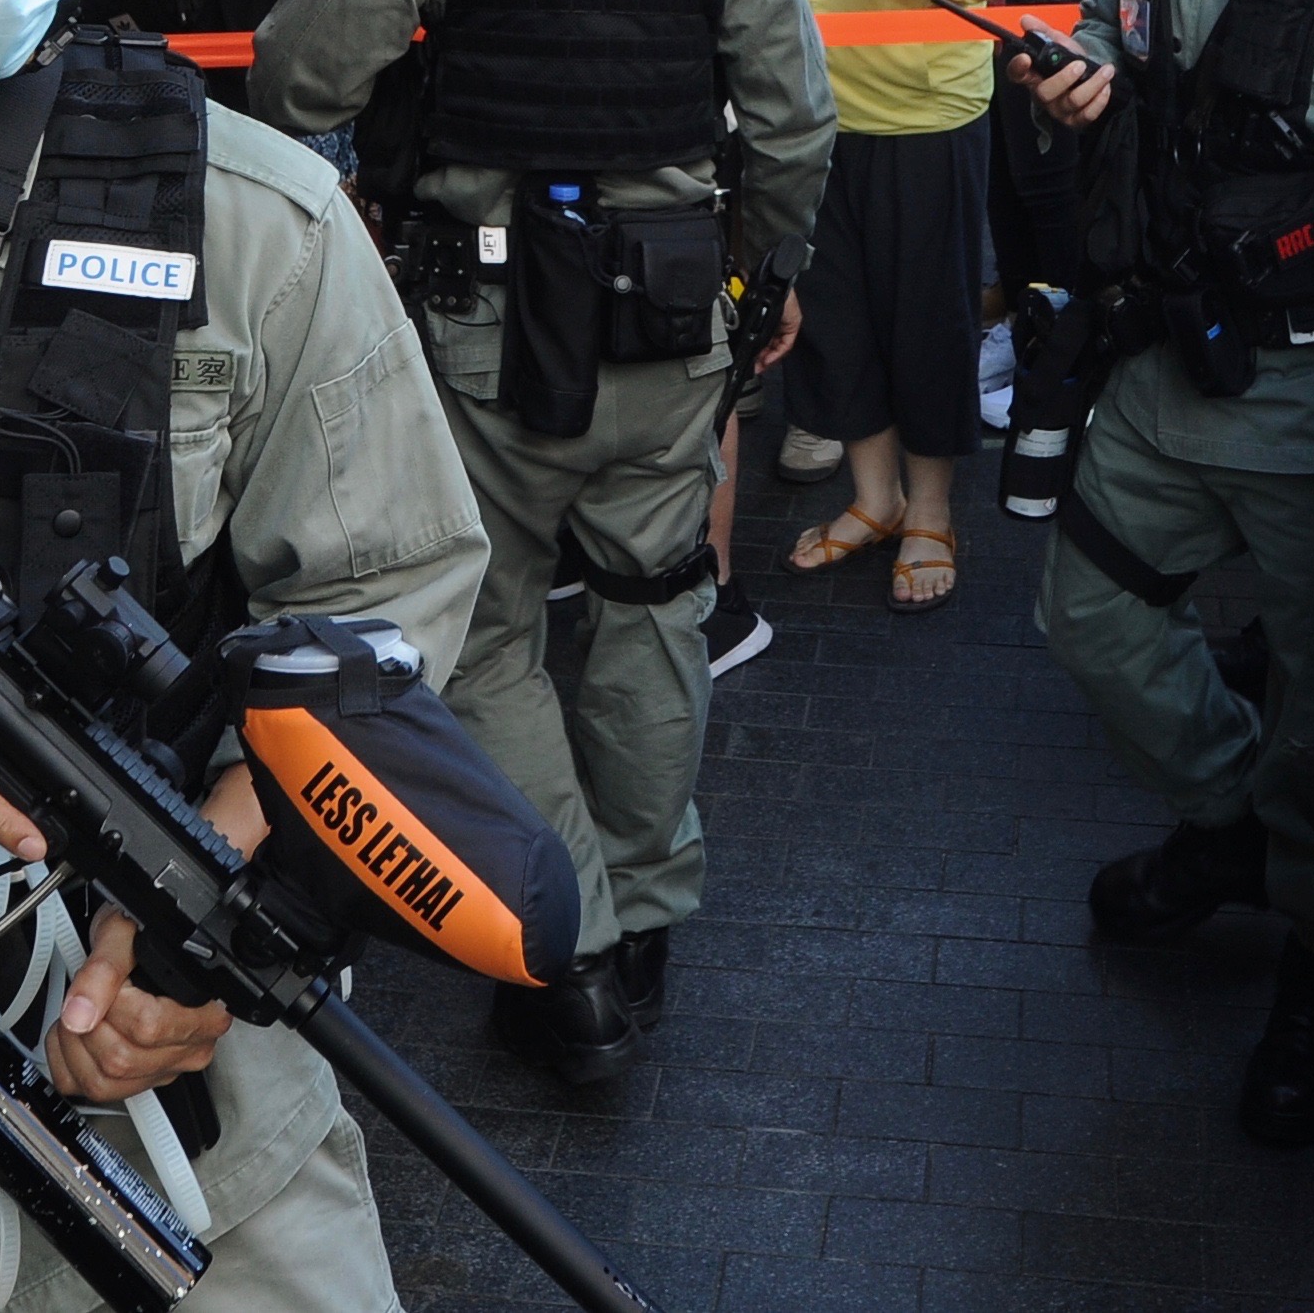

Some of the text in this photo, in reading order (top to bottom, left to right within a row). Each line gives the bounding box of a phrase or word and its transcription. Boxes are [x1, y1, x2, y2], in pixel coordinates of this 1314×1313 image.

[57, 252, 182, 288] POLICE
[197, 356, 227, 385] 察
[299, 760, 466, 933] LESS LETHAL
